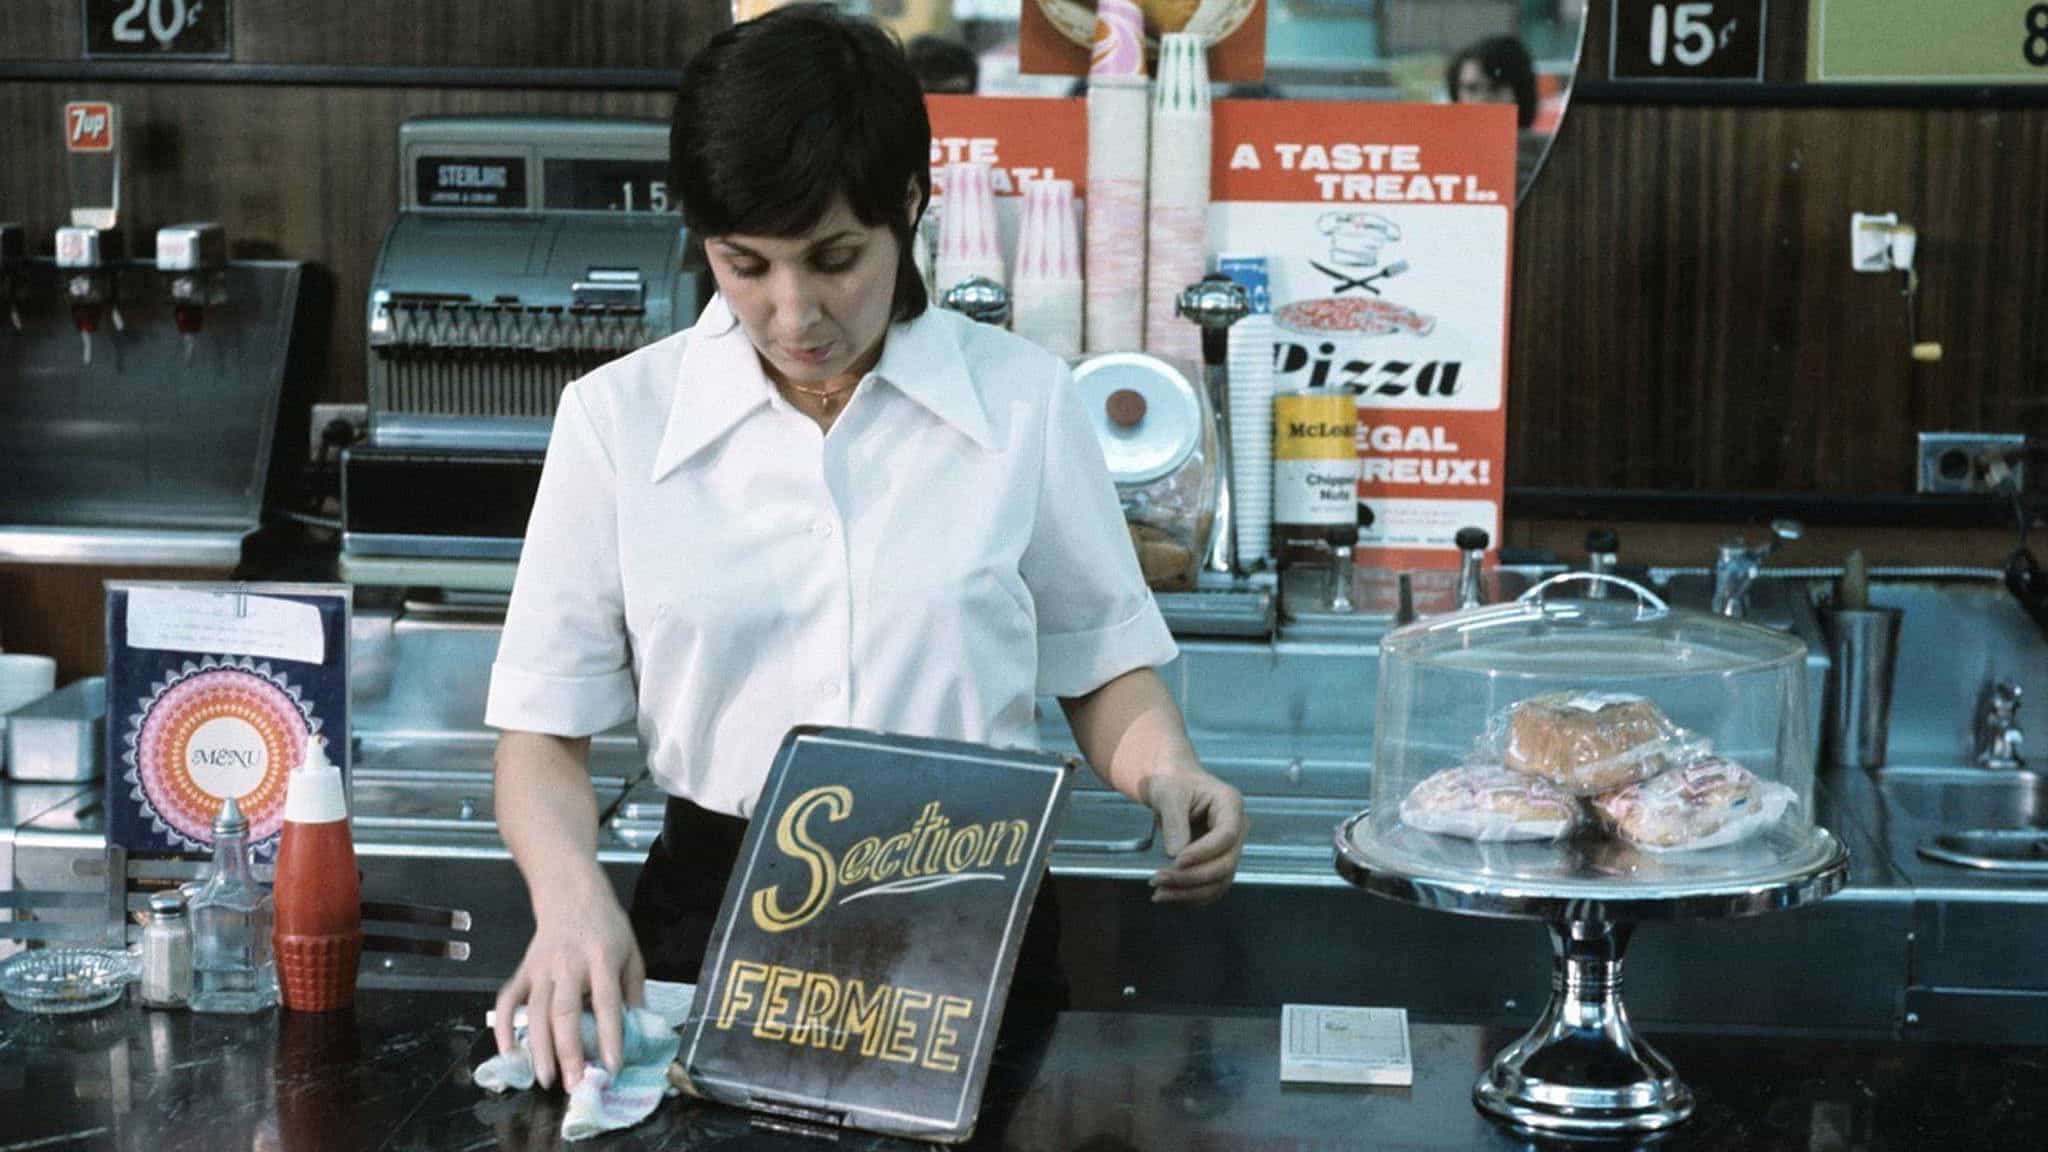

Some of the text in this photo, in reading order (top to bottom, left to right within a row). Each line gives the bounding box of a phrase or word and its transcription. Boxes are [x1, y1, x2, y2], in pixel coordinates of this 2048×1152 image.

[71, 109, 105, 141] 7up
[1230, 144, 1421, 171] A TASTE
[1273, 342, 1462, 396] Pizza
[1357, 458, 1491, 485] REUX!
[191, 748, 262, 768] MENU
[751, 786, 1030, 932] Section
[716, 960, 973, 1072] FERMEE
